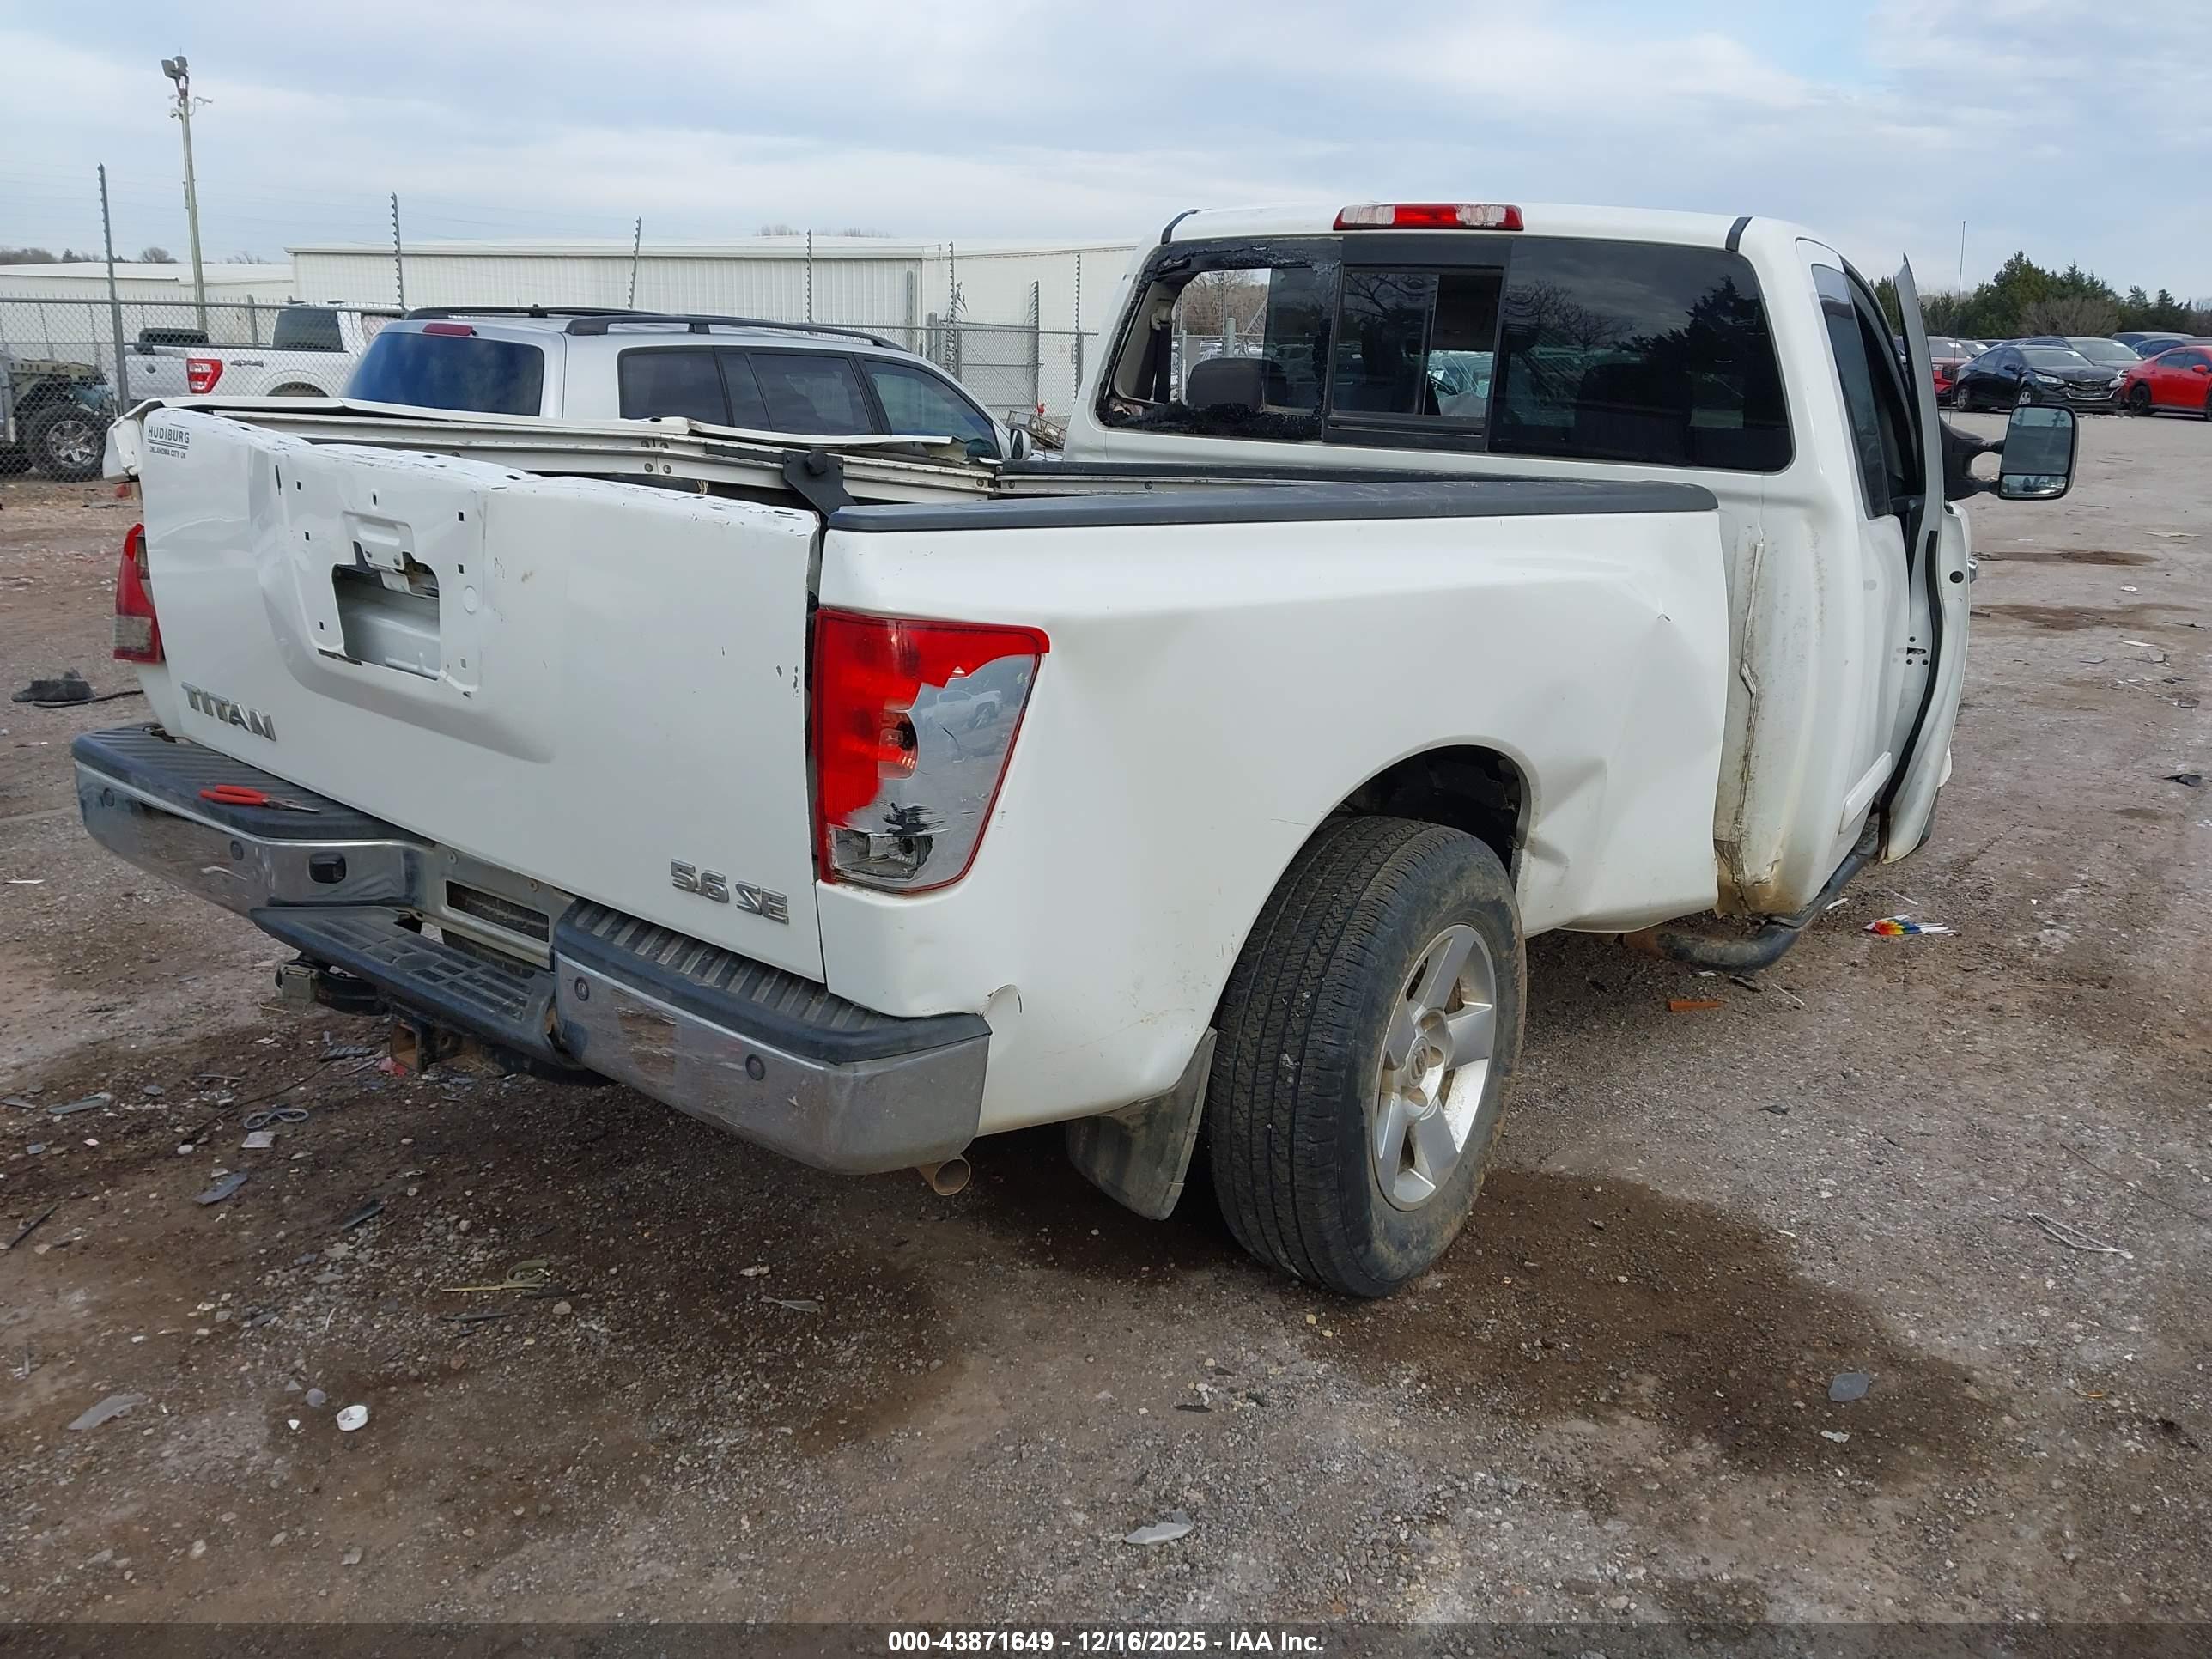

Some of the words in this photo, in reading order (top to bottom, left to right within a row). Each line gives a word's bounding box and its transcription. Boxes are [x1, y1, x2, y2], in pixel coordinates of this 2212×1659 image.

[148, 425, 190, 444] HUDIBURG
[180, 680, 276, 742] TITAN
[671, 858, 729, 903] 5.6
[735, 880, 789, 925] SE
